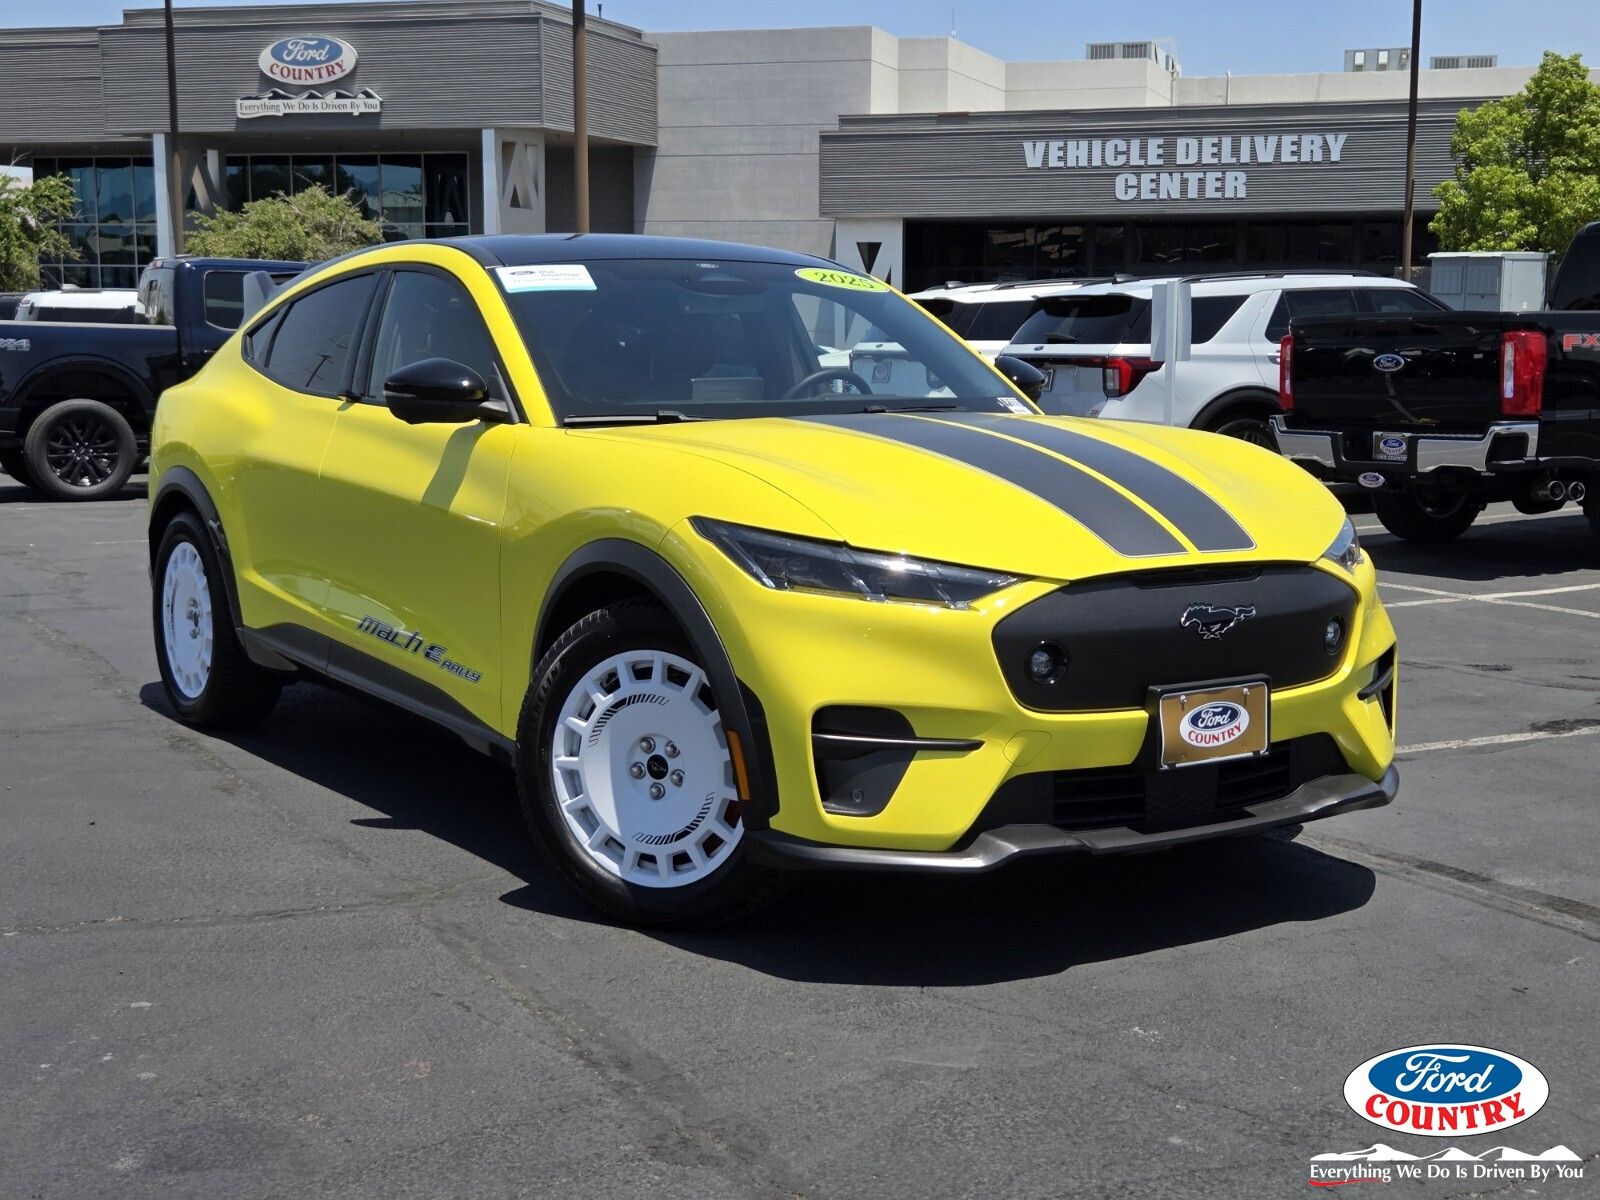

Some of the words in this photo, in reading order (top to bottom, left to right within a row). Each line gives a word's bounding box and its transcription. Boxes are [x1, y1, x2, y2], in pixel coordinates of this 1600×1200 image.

[283, 39, 330, 61] Ford
[269, 60, 346, 80] COUNTRY
[239, 102, 281, 113] Everything
[282, 102, 295, 110] We
[298, 102, 310, 110] Do
[312, 102, 319, 110] Is
[321, 102, 347, 110] Driven
[350, 102, 360, 113] By
[362, 102, 378, 110] You
[1023, 138, 1164, 168] VEHICLE
[1176, 133, 1349, 164] DELIVERY
[1114, 171, 1248, 200] CENTER
[814, 271, 875, 289] 2025
[441, 659, 482, 683] RALLY
[1198, 707, 1232, 728] Ford
[1188, 722, 1242, 744] COUNTRY
